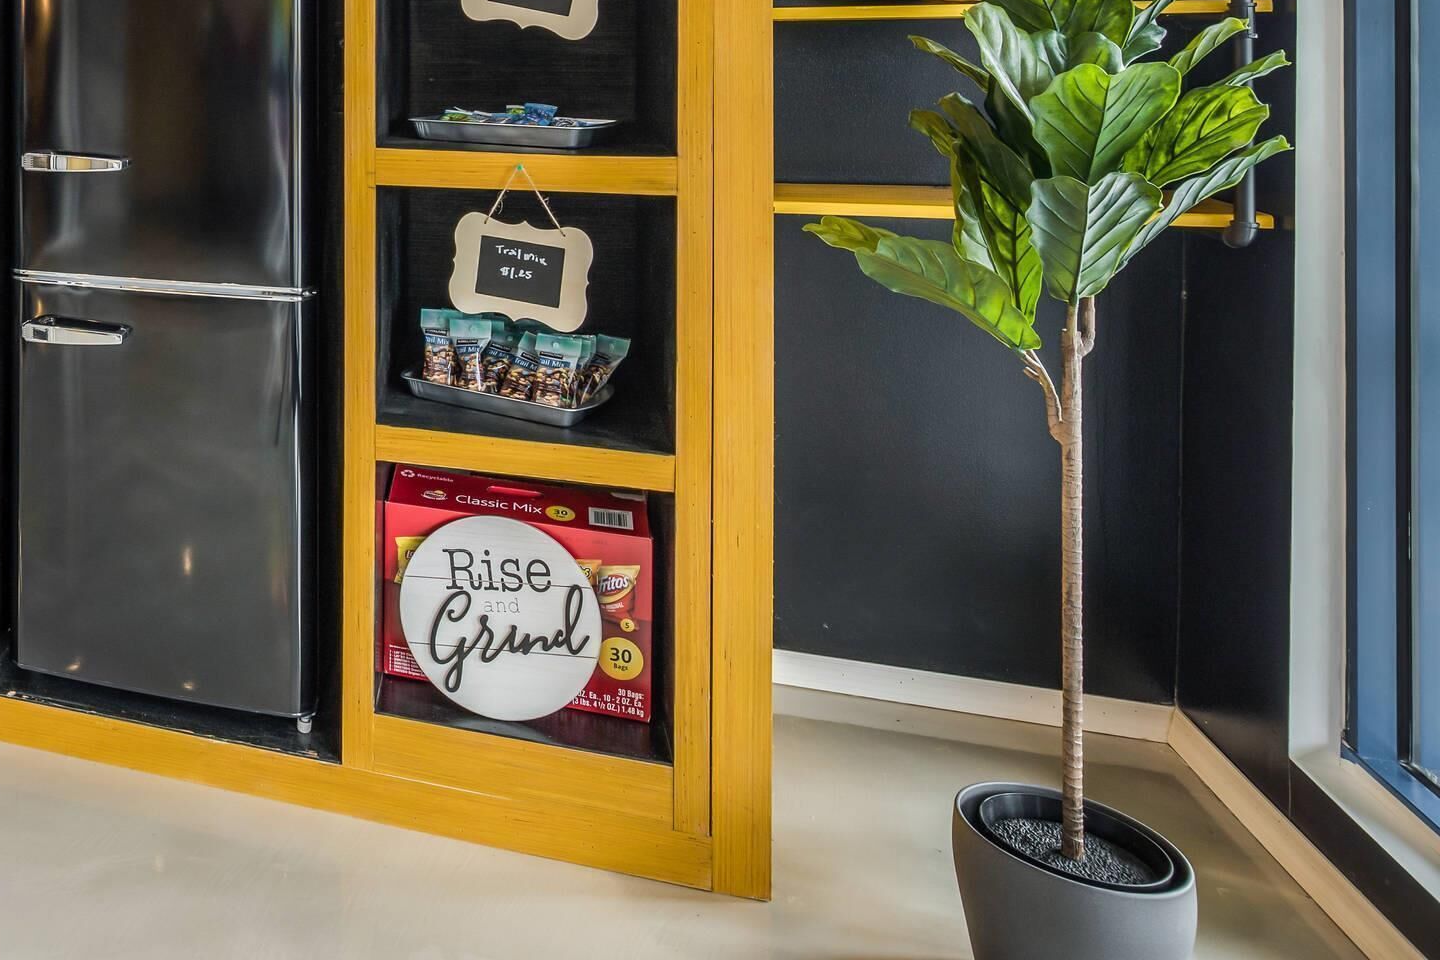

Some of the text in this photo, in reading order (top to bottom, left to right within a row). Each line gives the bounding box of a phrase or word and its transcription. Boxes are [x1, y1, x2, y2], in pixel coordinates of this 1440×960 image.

[455, 494, 509, 510] Classic
[512, 501, 542, 515] Mix
[442, 548, 552, 593] Rise
[483, 597, 521, 614] and
[430, 583, 590, 693] Grind
[609, 647, 632, 664] 30
[613, 662, 629, 672] Bags
[603, 694, 611, 702] 10
[617, 688, 626, 697] 30
[636, 708, 644, 718] kg
